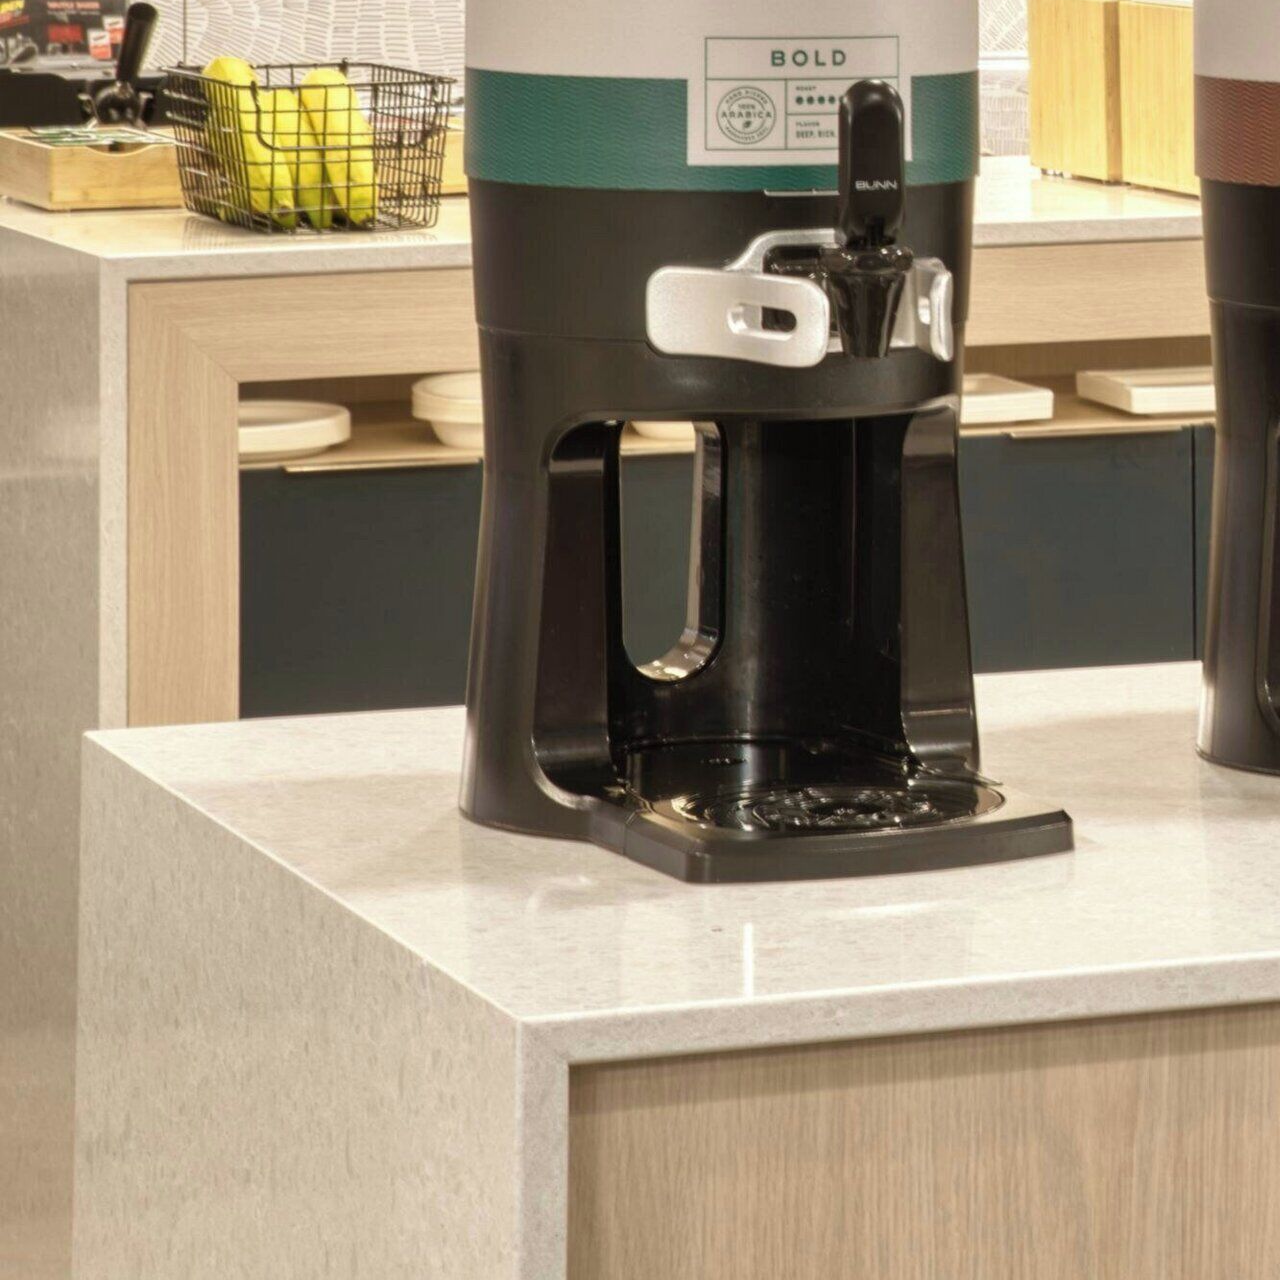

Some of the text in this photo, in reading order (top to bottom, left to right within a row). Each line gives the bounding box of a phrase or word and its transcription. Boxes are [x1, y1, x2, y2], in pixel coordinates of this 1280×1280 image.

[771, 50, 847, 67] BOLD
[721, 111, 772, 119] ARABICA
[855, 179, 898, 191] BUNN
